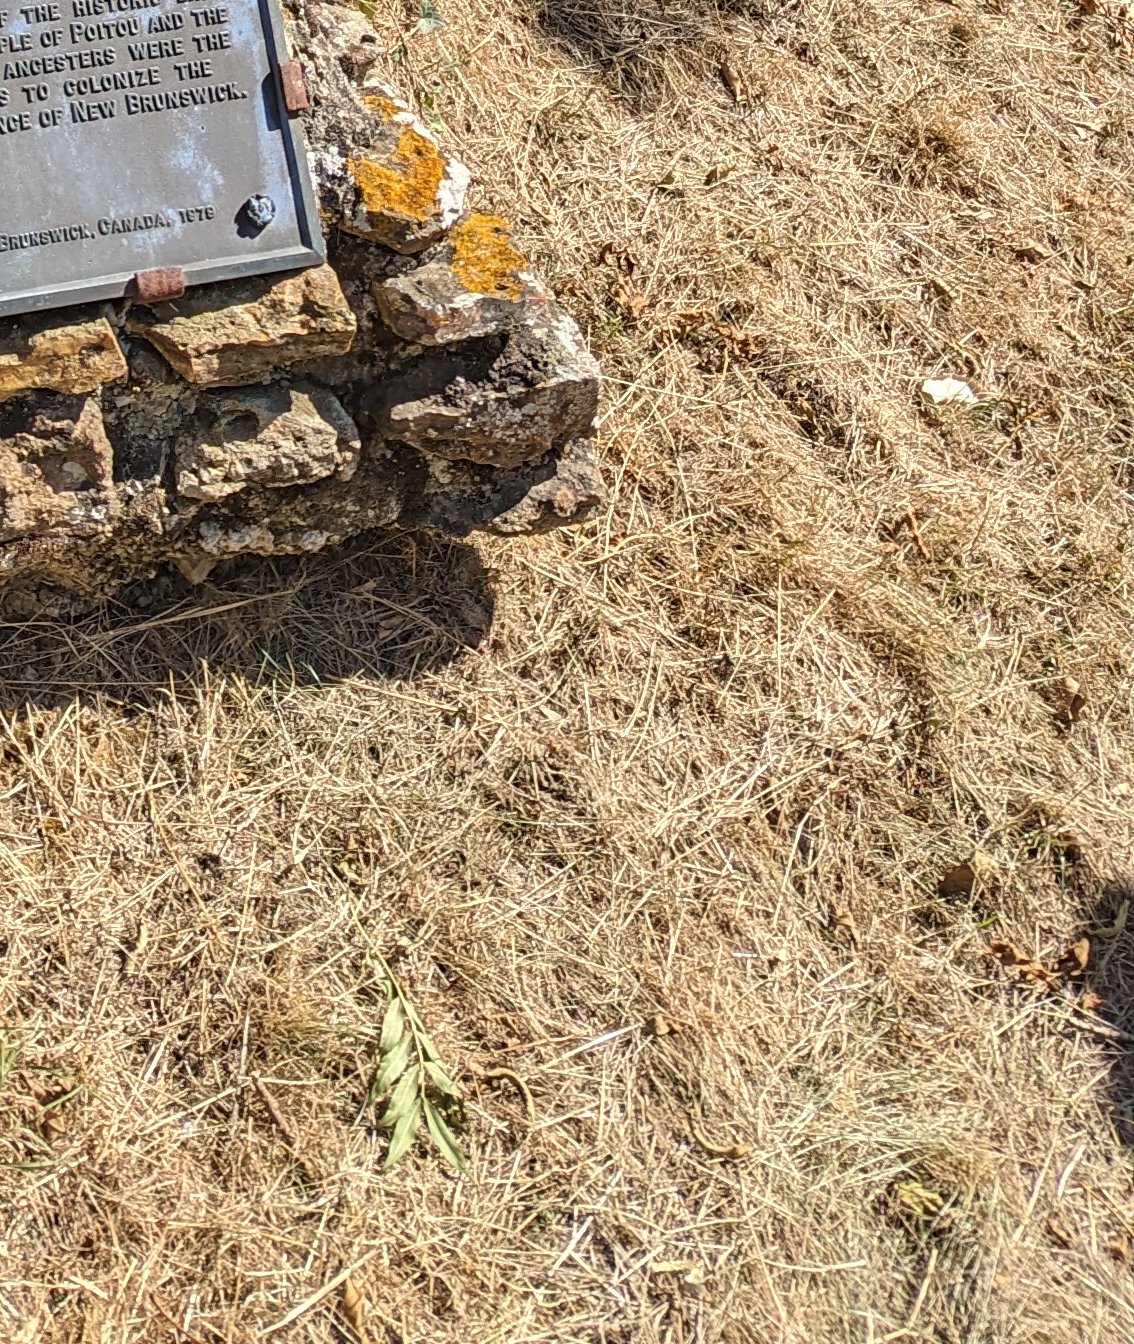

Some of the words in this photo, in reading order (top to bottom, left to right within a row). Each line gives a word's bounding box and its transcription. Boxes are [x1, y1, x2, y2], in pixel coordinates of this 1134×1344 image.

[20, 3, 61, 24] THE
[40, 29, 63, 48] OF
[70, 16, 140, 43] POITOU
[148, 11, 185, 34] AND
[190, 7, 229, 27] THE
[3, 47, 116, 79] ANCESTERS
[128, 37, 184, 61] WERE
[192, 31, 231, 53] THE
[22, 82, 50, 103] TO
[64, 66, 160, 97] COLONIZE
[174, 59, 213, 81] THE
[39, 108, 63, 129] OF
[69, 99, 116, 123] NEW
